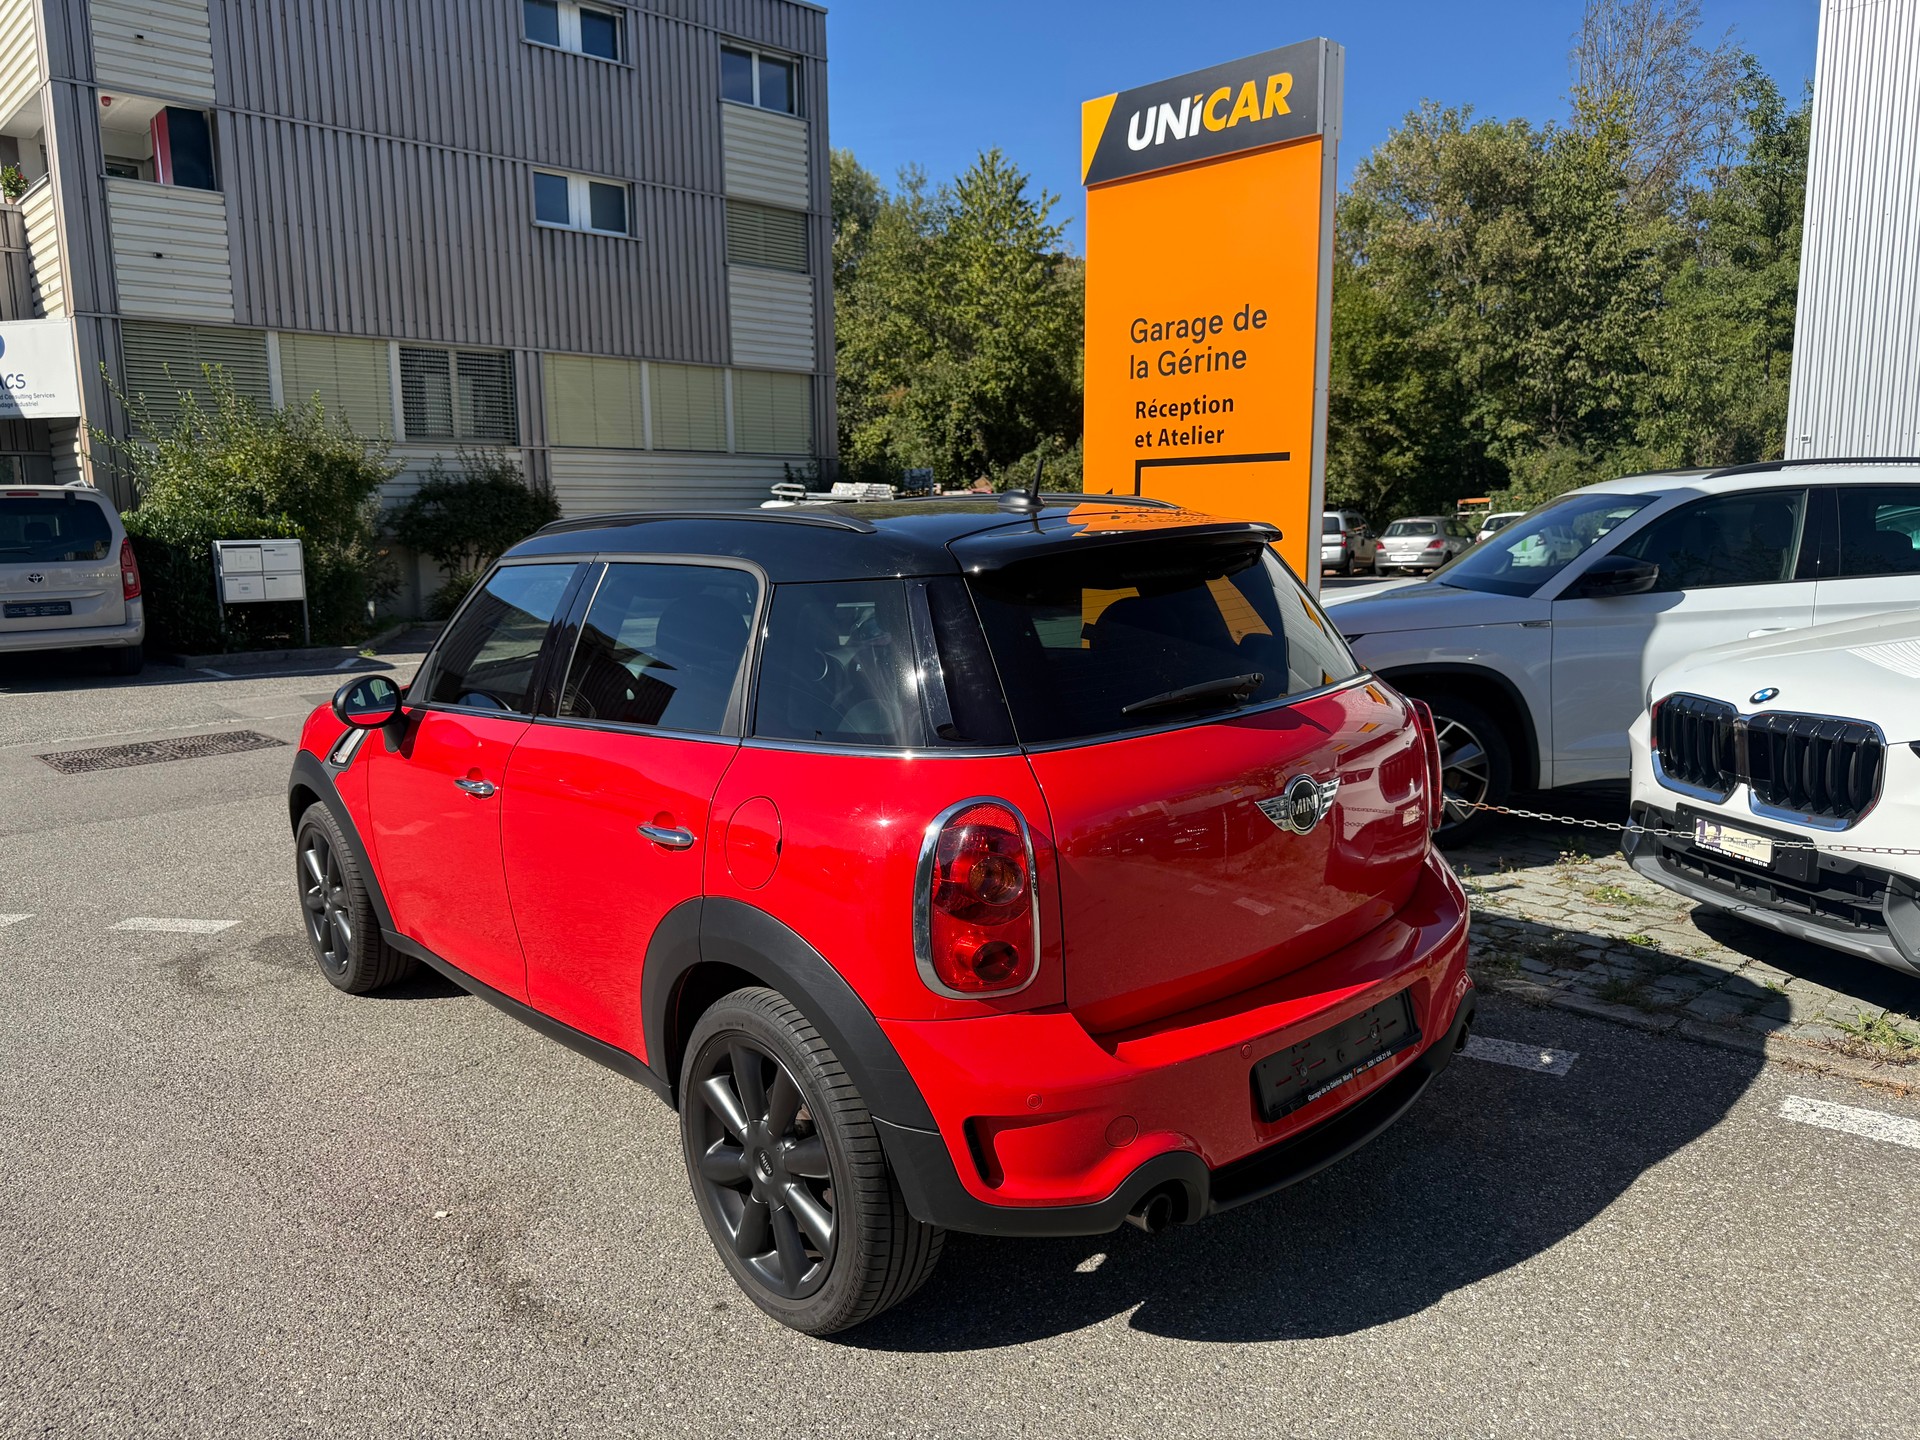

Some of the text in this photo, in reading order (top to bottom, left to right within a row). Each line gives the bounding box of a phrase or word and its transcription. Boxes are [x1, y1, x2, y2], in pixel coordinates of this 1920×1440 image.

[1130, 303, 1268, 344] Garage de
[1129, 345, 1247, 380] la Gérine
[1135, 394, 1234, 421] Réception
[1134, 424, 1225, 448] et Atelier
[1291, 794, 1319, 816] MINI
